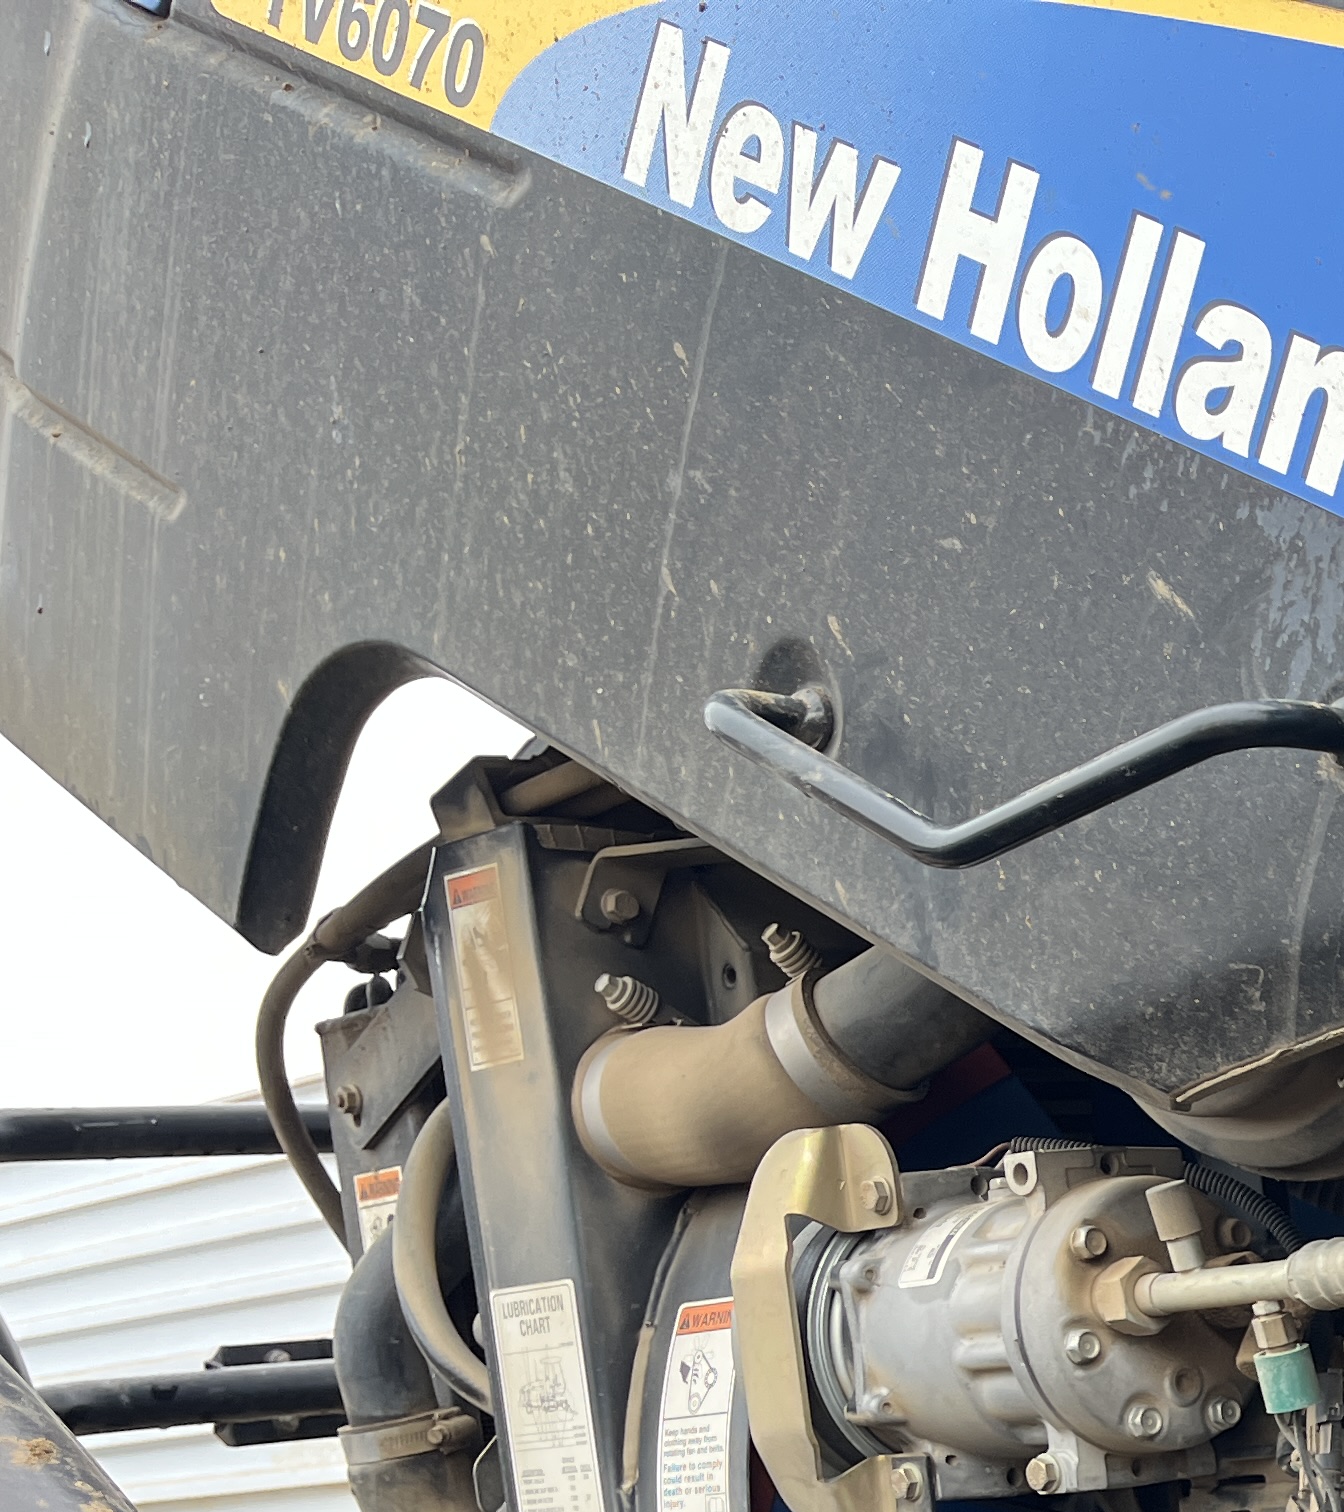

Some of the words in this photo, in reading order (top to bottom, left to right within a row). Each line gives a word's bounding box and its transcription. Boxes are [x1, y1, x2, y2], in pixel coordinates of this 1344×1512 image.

[623, 19, 902, 281] New
[502, 1294, 564, 1319] LUBRICATION
[519, 1316, 551, 1337] CHART
[664, 1463, 687, 1473] Failure
[689, 1462, 696, 1471] to
[698, 1459, 722, 1470] comply
[664, 1475, 682, 1485] could
[684, 1472, 704, 1483] result
[707, 1472, 714, 1481] in
[664, 1487, 682, 1497] death
[685, 1487, 692, 1496] or
[695, 1484, 720, 1495] serious
